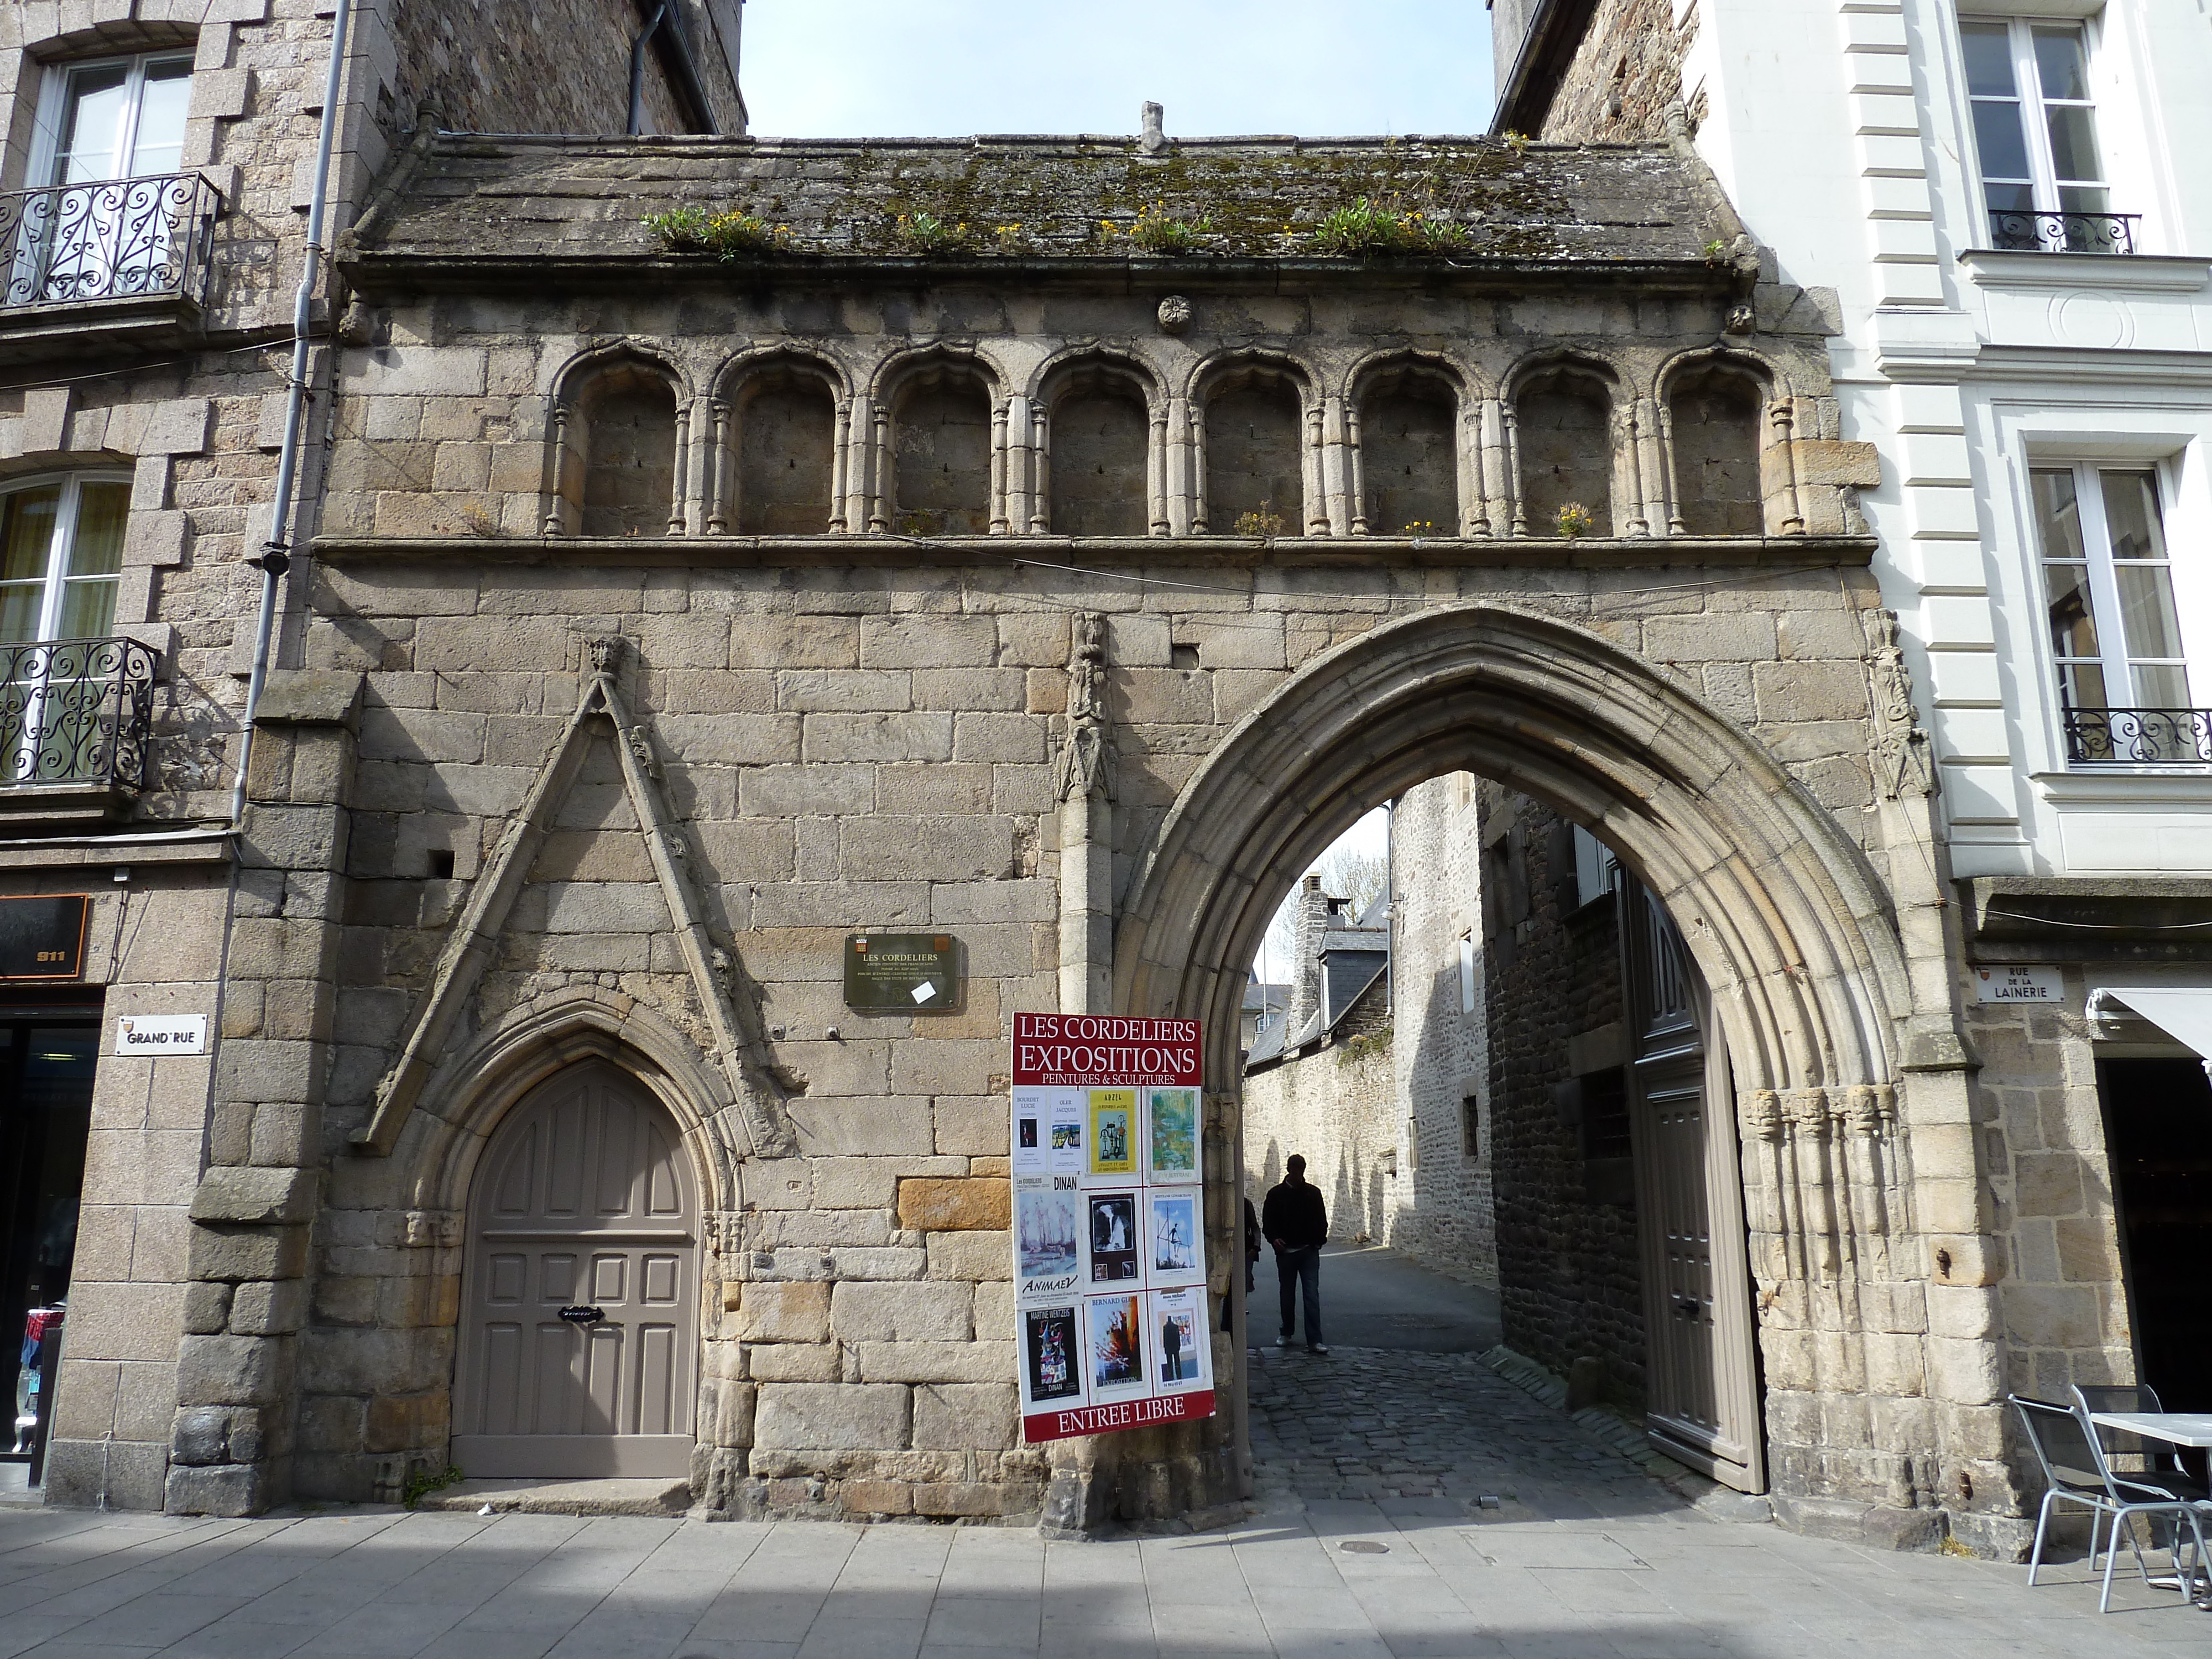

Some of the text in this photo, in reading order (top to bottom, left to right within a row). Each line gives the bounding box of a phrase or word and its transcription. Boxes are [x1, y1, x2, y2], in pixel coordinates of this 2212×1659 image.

[36, 951, 65, 962] 911
[1995, 987, 2047, 998] LAINERIE
[1020, 1016, 1196, 1042] LES CORDELIERS
[1020, 1045, 1195, 1073] EXPOSITIONS
[1042, 1073, 1175, 1085] PEINTURES & SCULPTURES
[1054, 1176, 1077, 1191] DINAN
[1092, 1297, 1120, 1306] BERNARD
[1031, 1311, 1048, 1321] MARTINE
[1103, 1376, 1137, 1386] EXPOSITION
[1048, 1383, 1062, 1392] DINAN
[1057, 1396, 1185, 1433] ENTREE LIBRE
